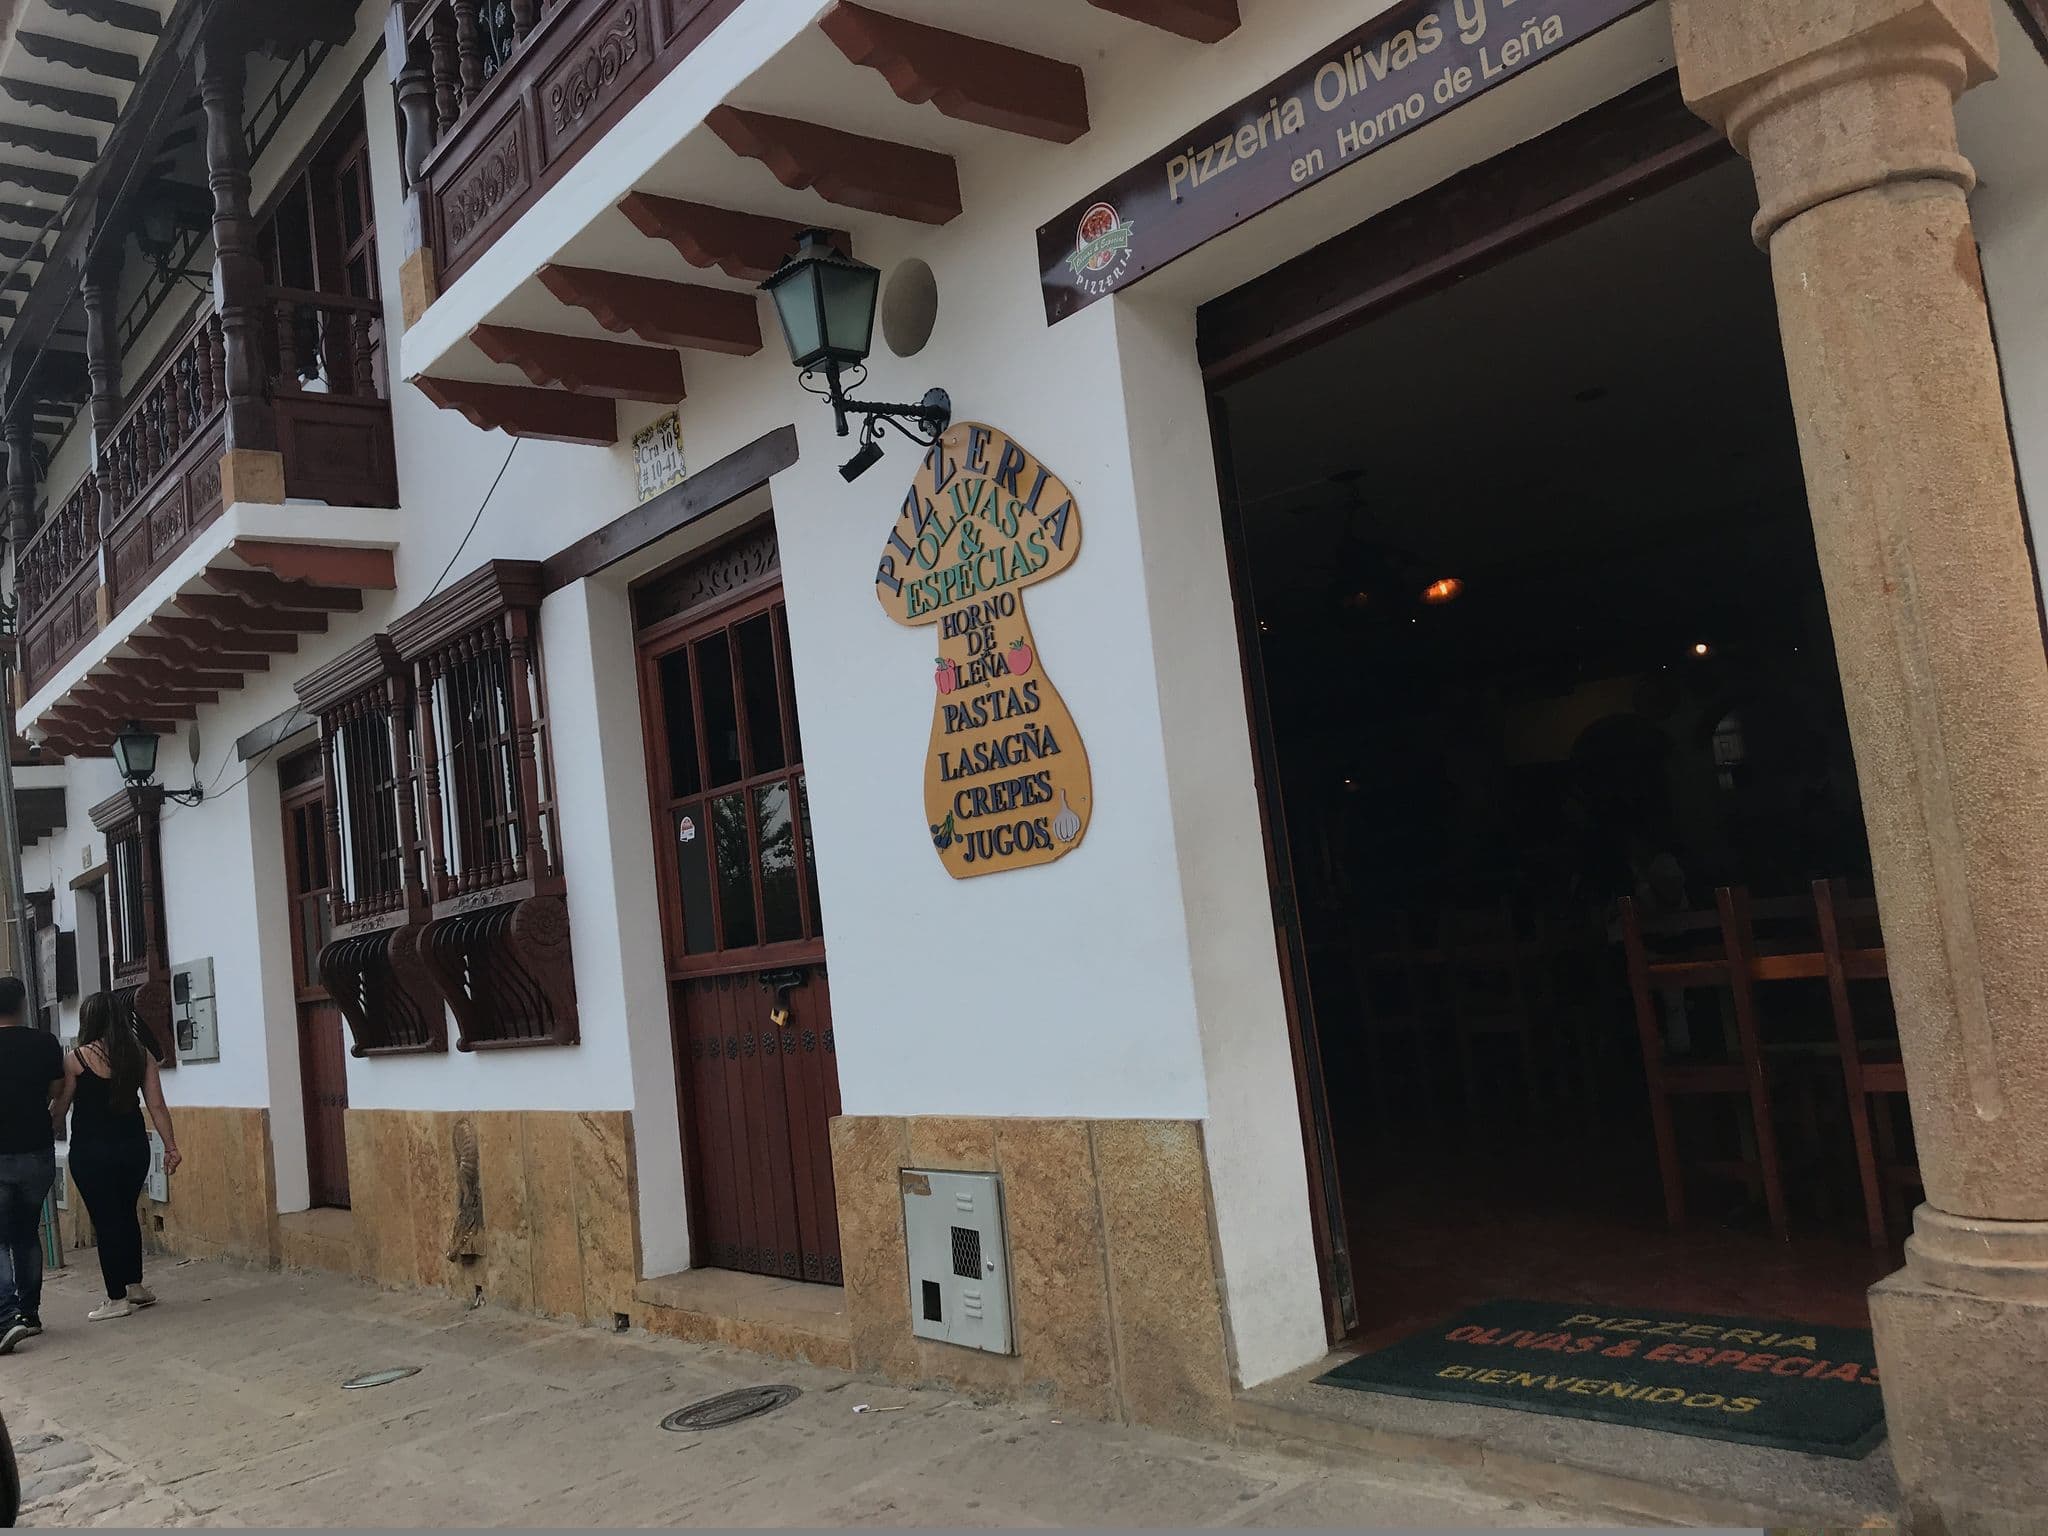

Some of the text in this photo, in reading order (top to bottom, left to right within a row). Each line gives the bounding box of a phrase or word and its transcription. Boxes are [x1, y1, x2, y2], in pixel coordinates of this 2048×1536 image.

[1166, 0, 1487, 200] Pizzeria Olivas y
[1290, 14, 1564, 183] en Horno de Leña
[1076, 248, 1132, 295] PIZZERIA
[641, 431, 673, 464] Cra 10
[875, 425, 1072, 598] PIZZERIA
[915, 478, 1025, 570] OLIVAS
[957, 520, 985, 560] &
[903, 527, 1049, 619] ESPECIAS
[941, 592, 1016, 640] HORNO
[966, 624, 998, 656] DE
[954, 649, 1012, 690] LEÑA
[942, 680, 1041, 734] PASTAS
[938, 723, 1061, 782] LASAGÑA
[953, 770, 1053, 820] CREPES
[1445, 1325, 1604, 1354] OLIVAS
[1600, 1339, 1641, 1358] &
[1558, 1314, 1816, 1351] PIZZERIA
[1433, 1365, 1761, 1412] BIENVENIDOS
